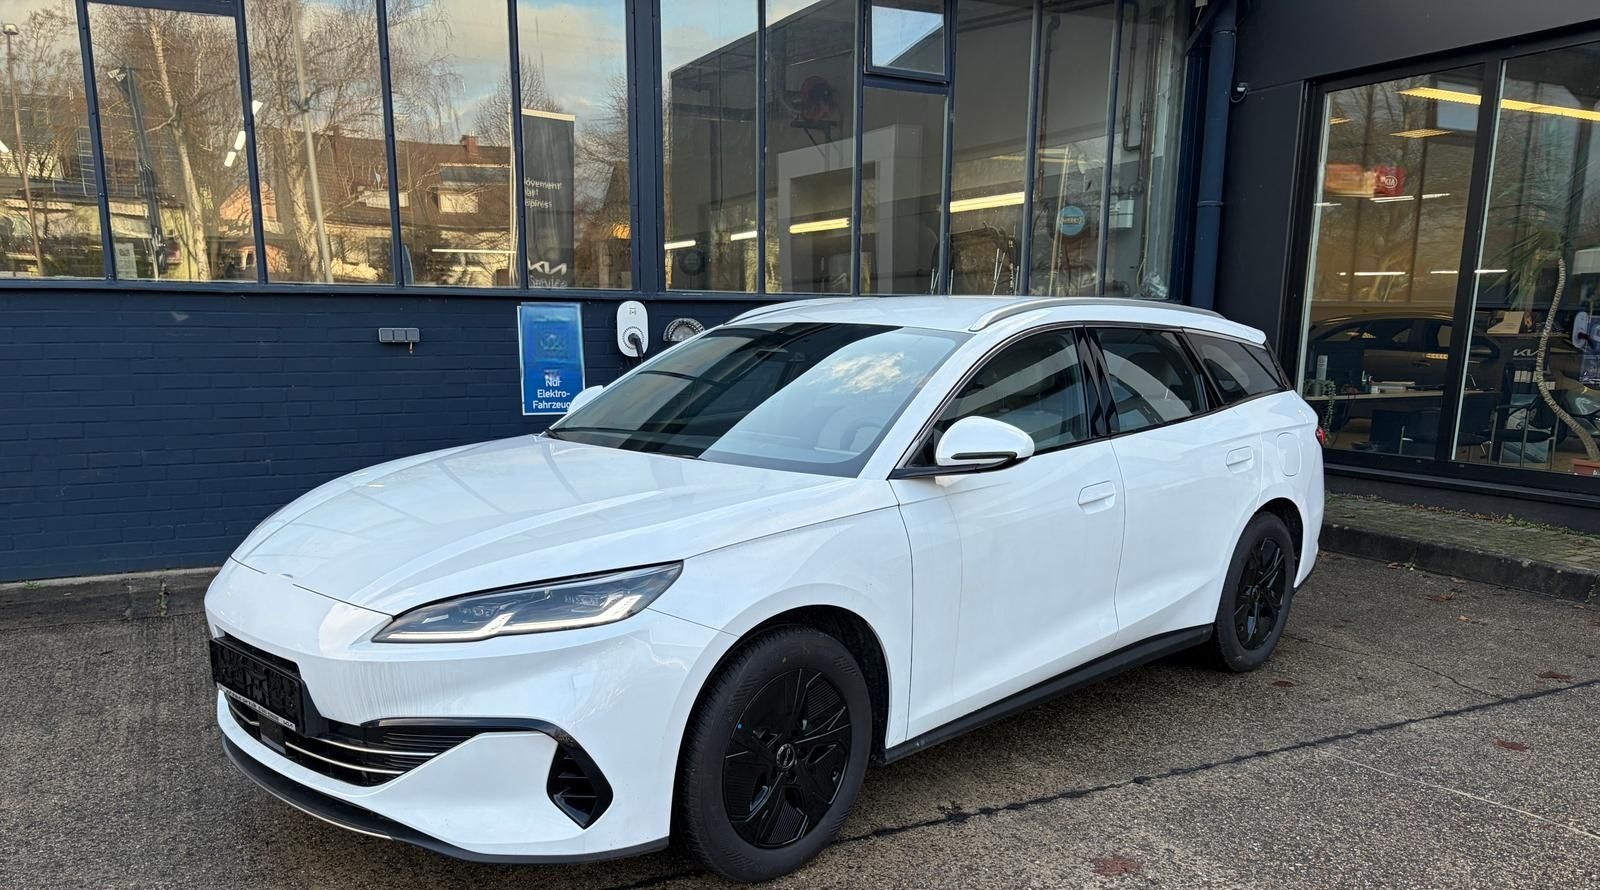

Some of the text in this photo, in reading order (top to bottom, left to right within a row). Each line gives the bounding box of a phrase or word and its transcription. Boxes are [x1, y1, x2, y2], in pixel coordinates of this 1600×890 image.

[524, 178, 562, 190] ovement
[528, 258, 567, 275] KIA
[545, 378, 562, 387] Nur
[537, 389, 571, 398] Elektro-
